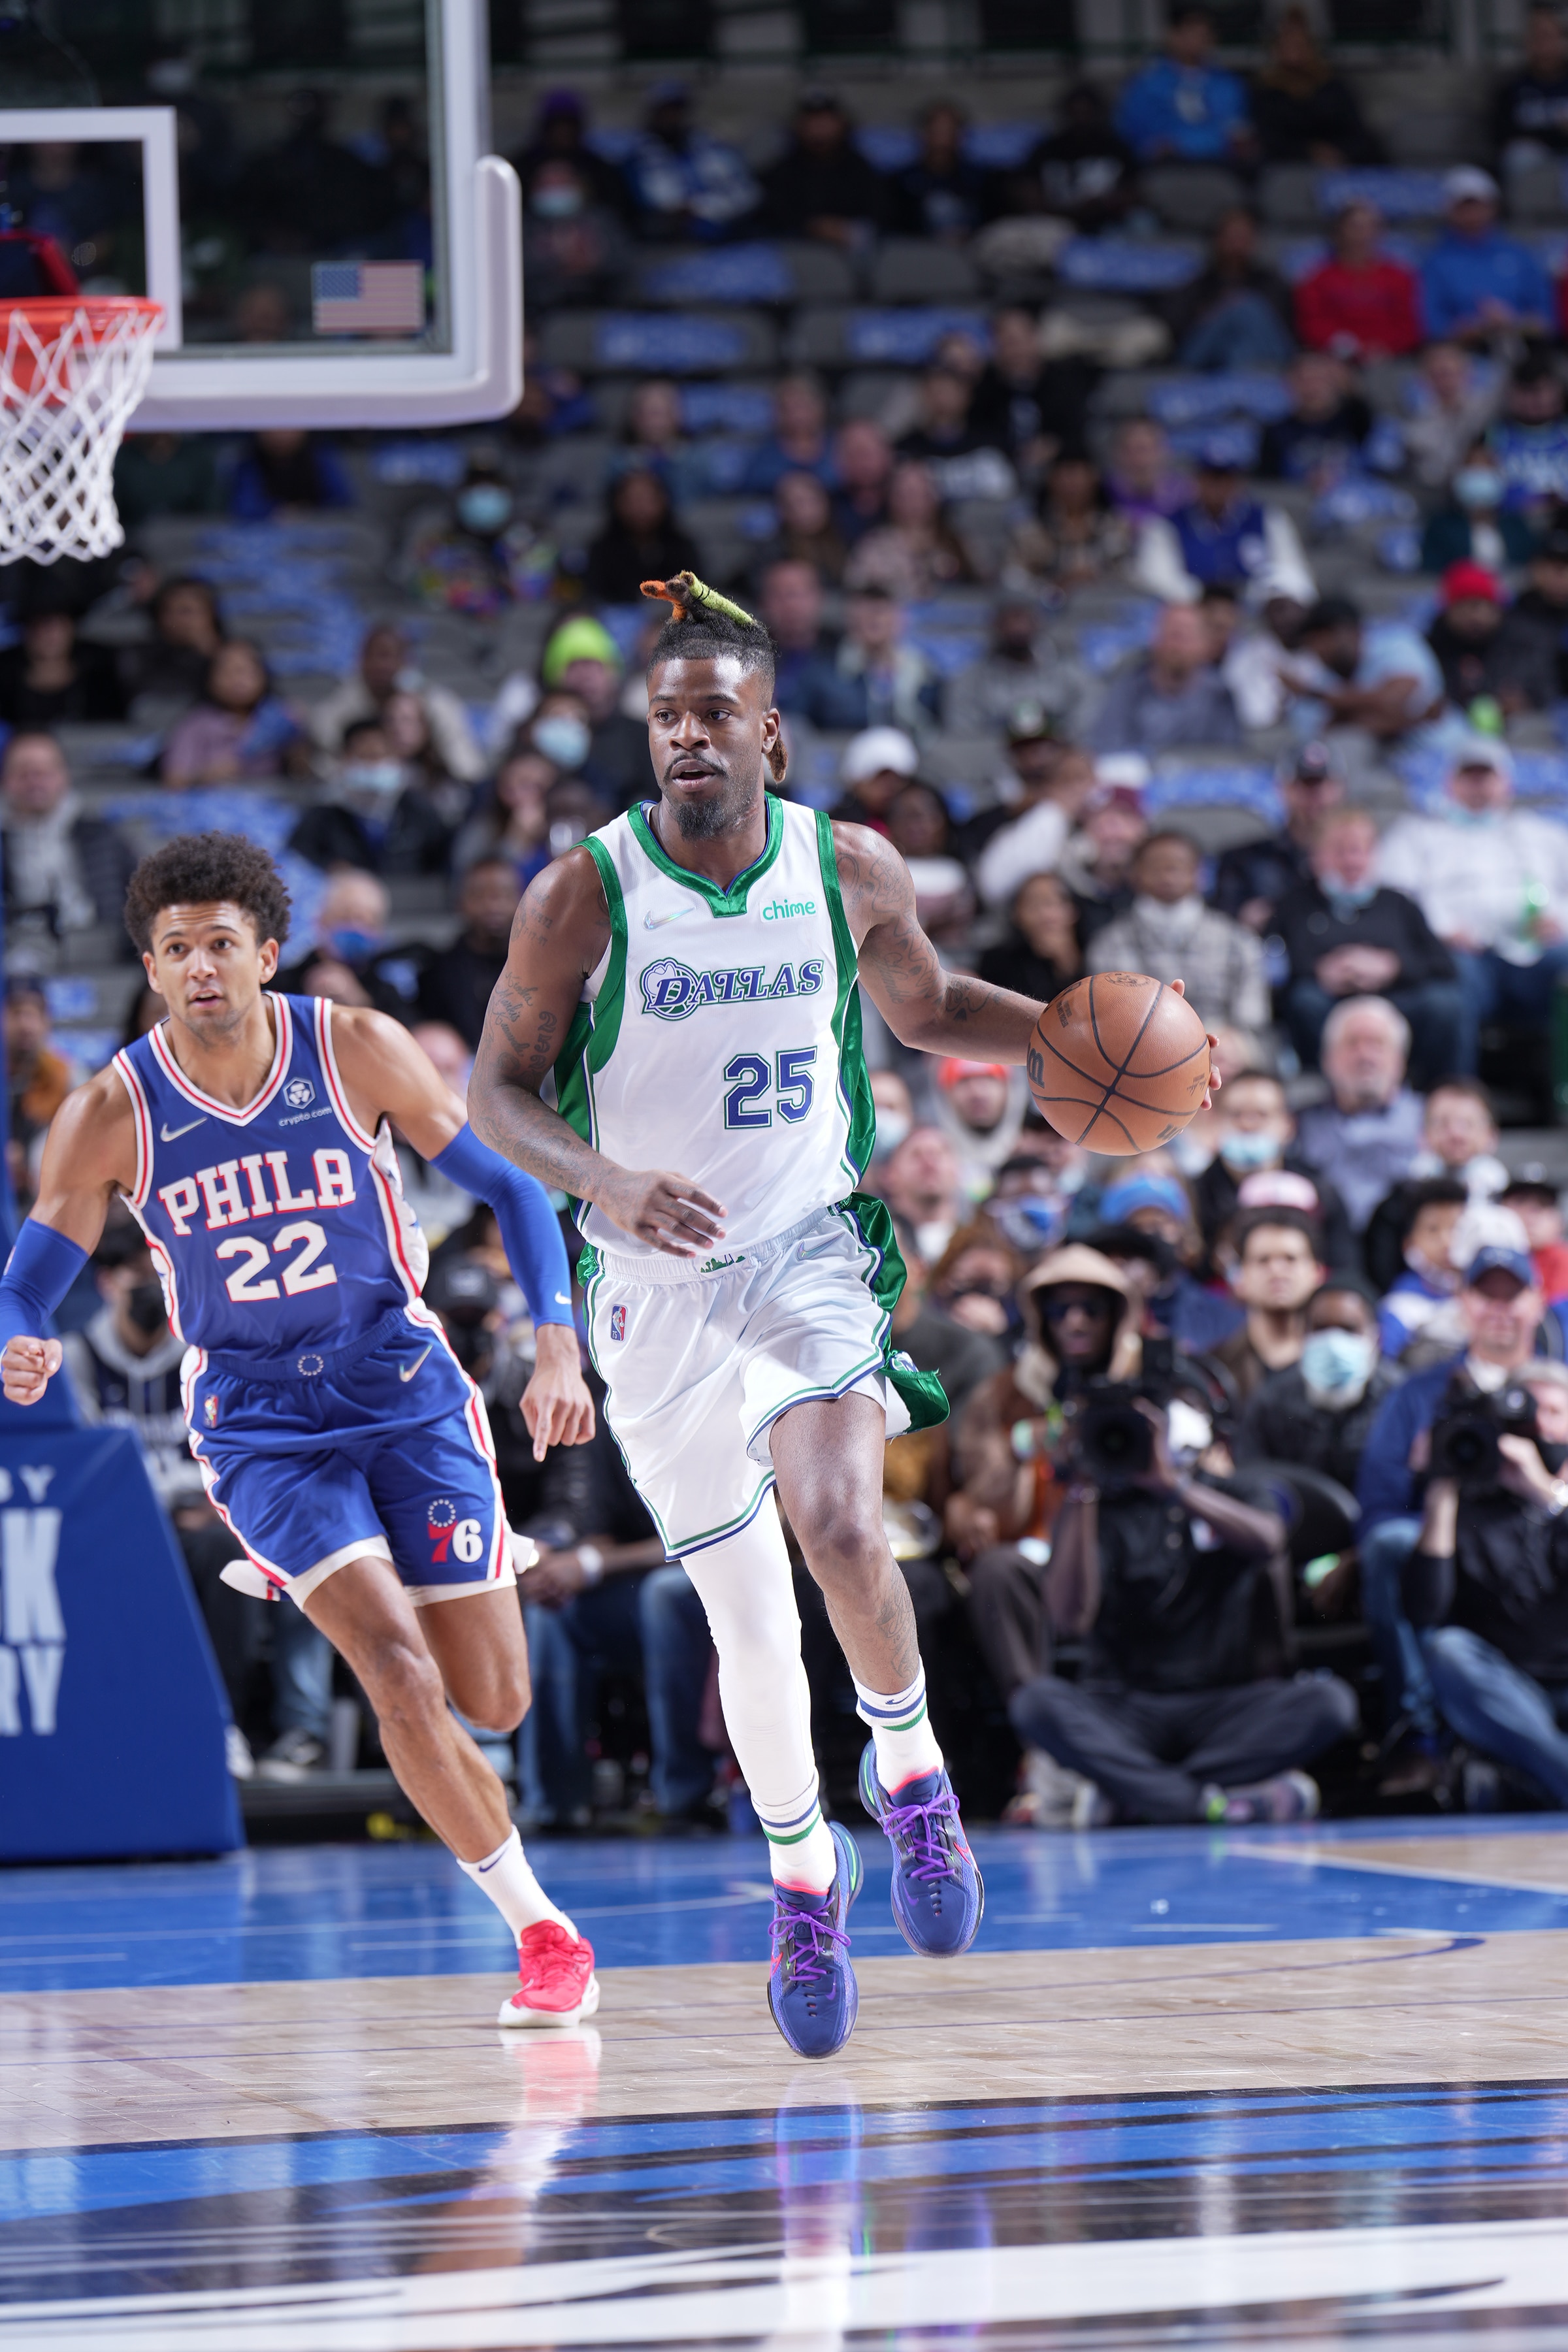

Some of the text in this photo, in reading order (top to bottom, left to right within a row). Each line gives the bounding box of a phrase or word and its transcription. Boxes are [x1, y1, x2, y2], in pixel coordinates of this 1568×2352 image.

[762, 898, 816, 921] chime
[641, 958, 825, 1015] DALLAS
[724, 1046, 817, 1130] 25
[278, 1106, 333, 1126] crypto.com
[158, 1148, 356, 1236] PHILA
[216, 1220, 338, 1302] 22
[612, 1330, 617, 1339] 75
[427, 1518, 483, 1563] 76
